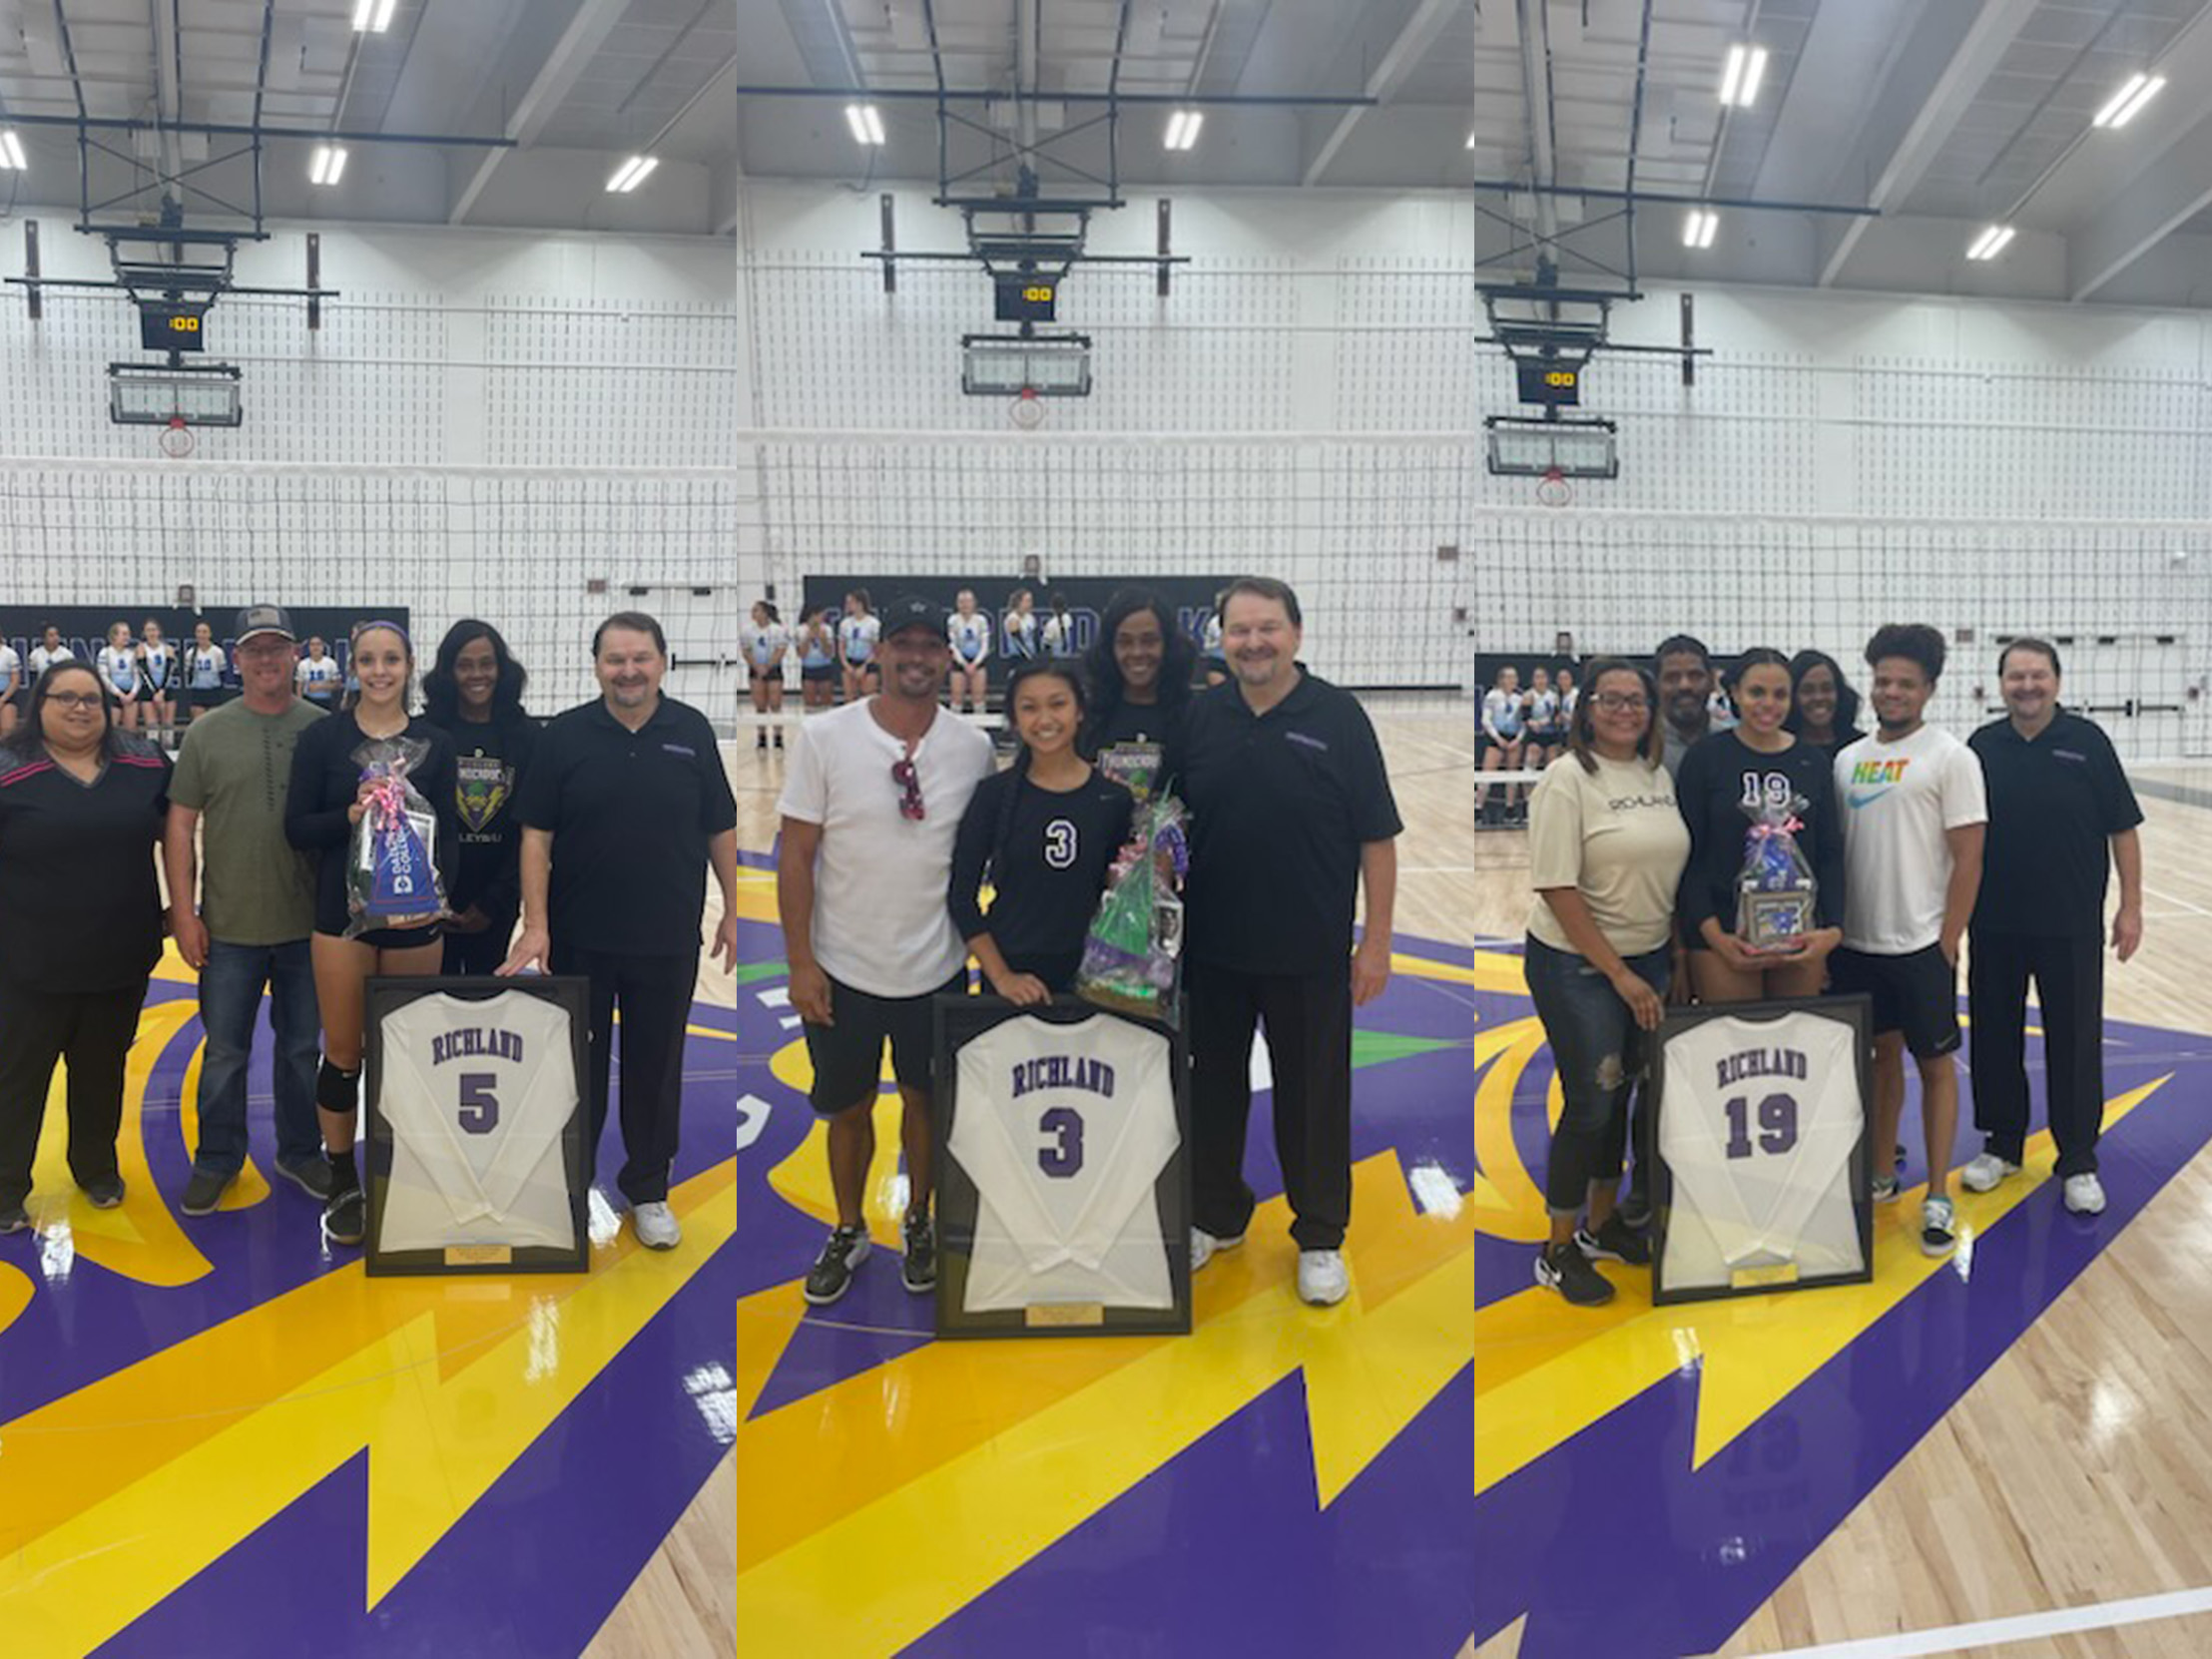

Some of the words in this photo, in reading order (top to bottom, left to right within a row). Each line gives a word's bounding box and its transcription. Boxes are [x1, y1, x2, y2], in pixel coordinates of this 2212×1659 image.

[1743, 772, 1790, 807] 19
[1851, 759, 1910, 785] HEAT
[1045, 820, 1077, 868] 3
[432, 1027, 523, 1065] RICHLAND
[1012, 1056, 1115, 1098] RICHLAND
[1716, 1048, 1807, 1090] RICHLAND
[458, 1073, 499, 1134] 5
[1038, 1107, 1084, 1178] 3
[1725, 1092, 1798, 1160] 19
